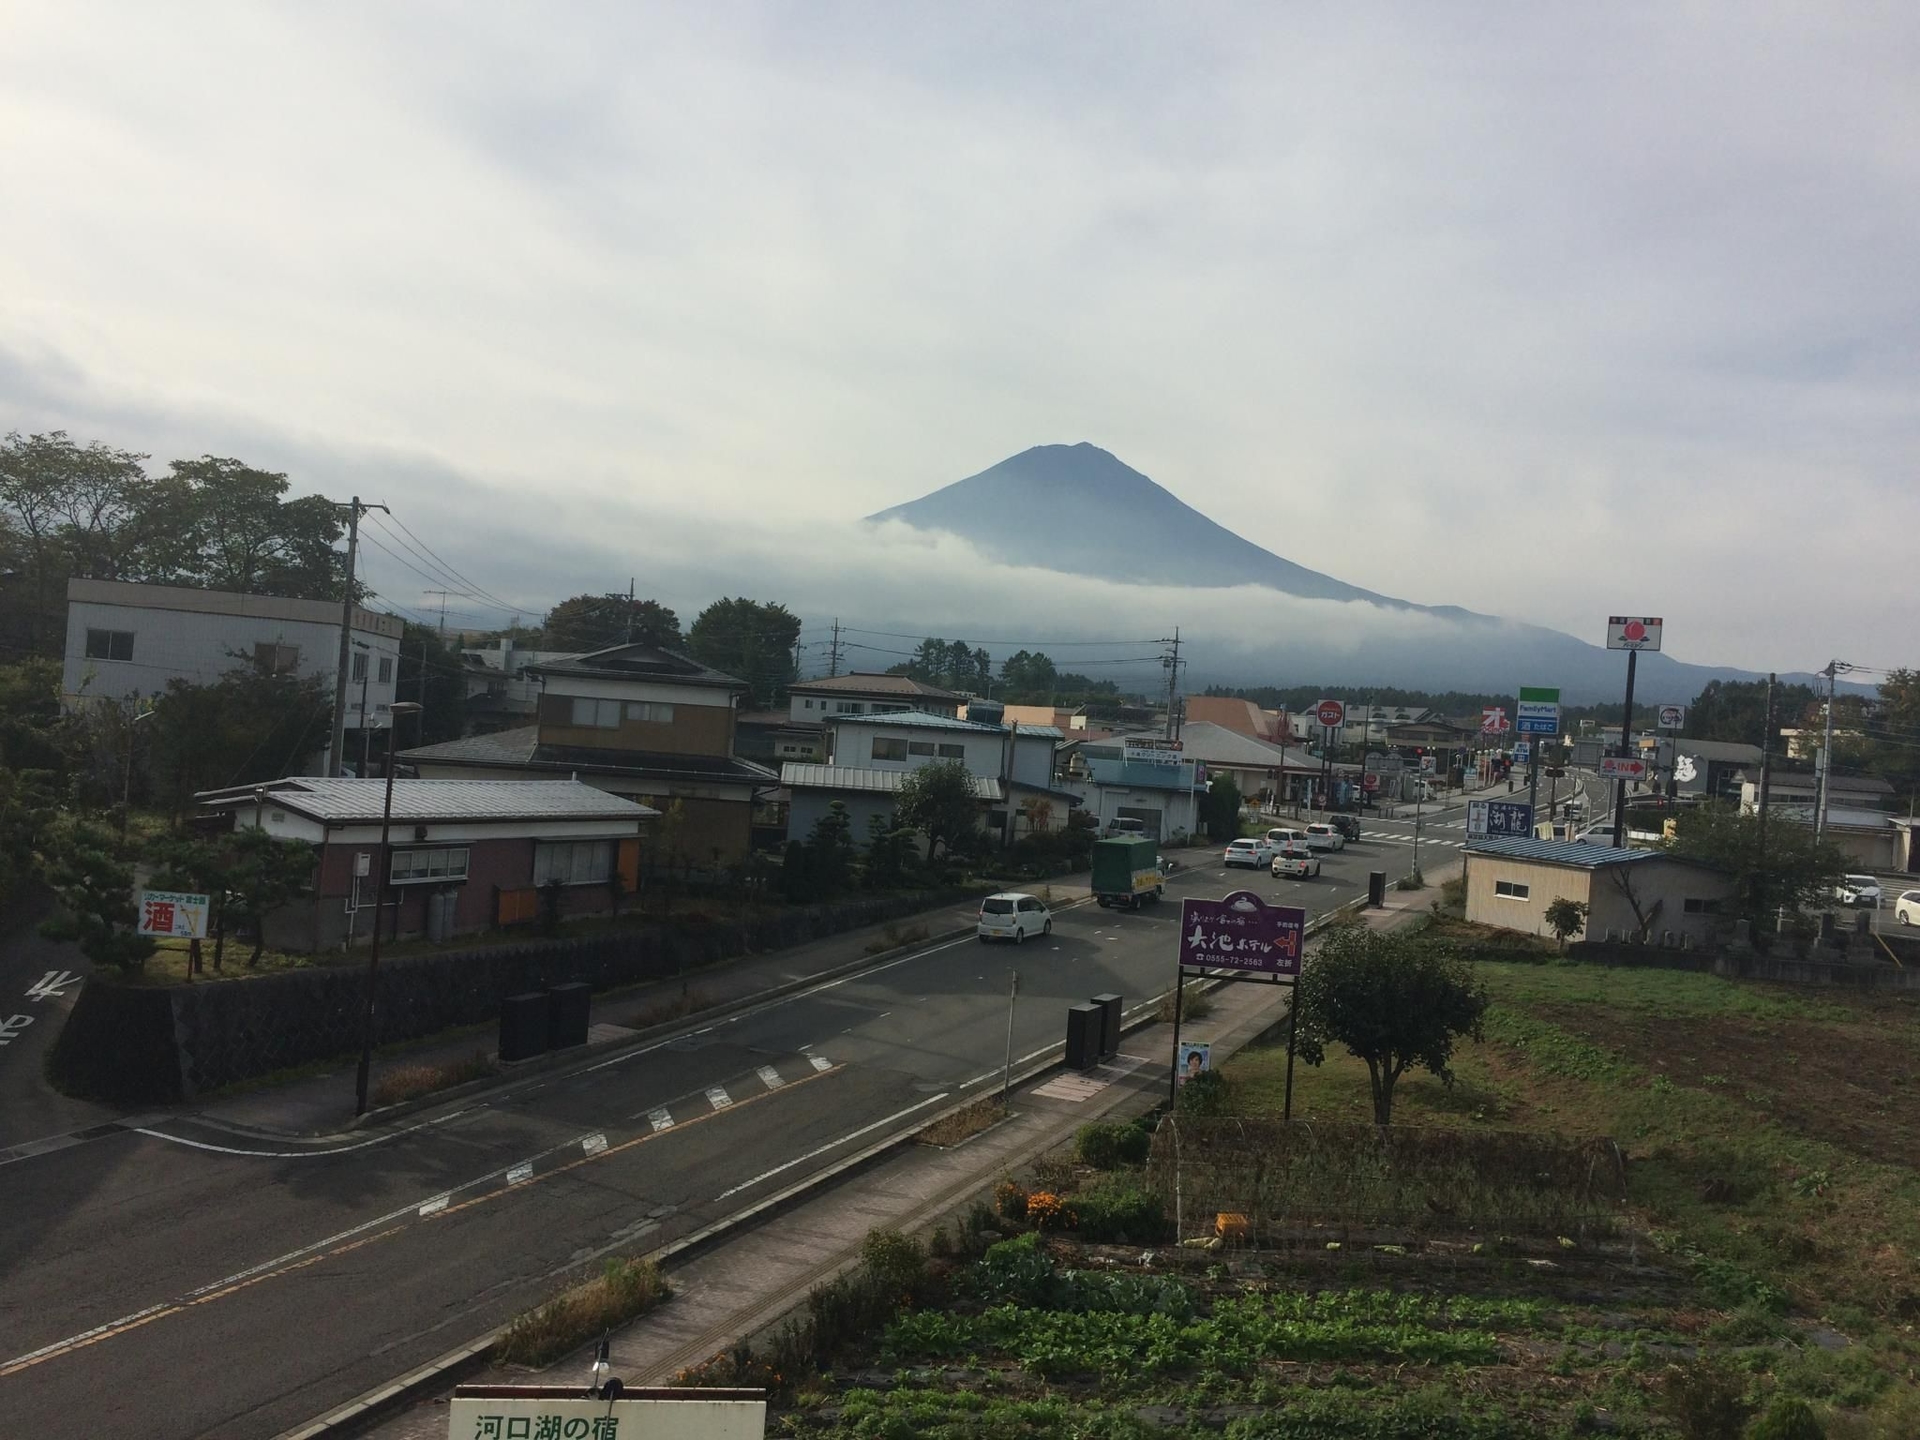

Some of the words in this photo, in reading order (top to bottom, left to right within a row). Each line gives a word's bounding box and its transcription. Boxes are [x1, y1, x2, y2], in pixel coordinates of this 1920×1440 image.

[1520, 704, 1556, 713] FamilyMart
[1321, 711, 1341, 719] ガスト
[1534, 723, 1554, 731] たばこ
[1617, 762, 1630, 771] IN
[143, 901, 175, 933] 酒
[1187, 924, 1272, 953] 大池ホテル
[1206, 954, 1263, 966] 0555-72-2563
[1276, 958, 1293, 967] 左折
[474, 1415, 619, 1440] 河口湖の宿
